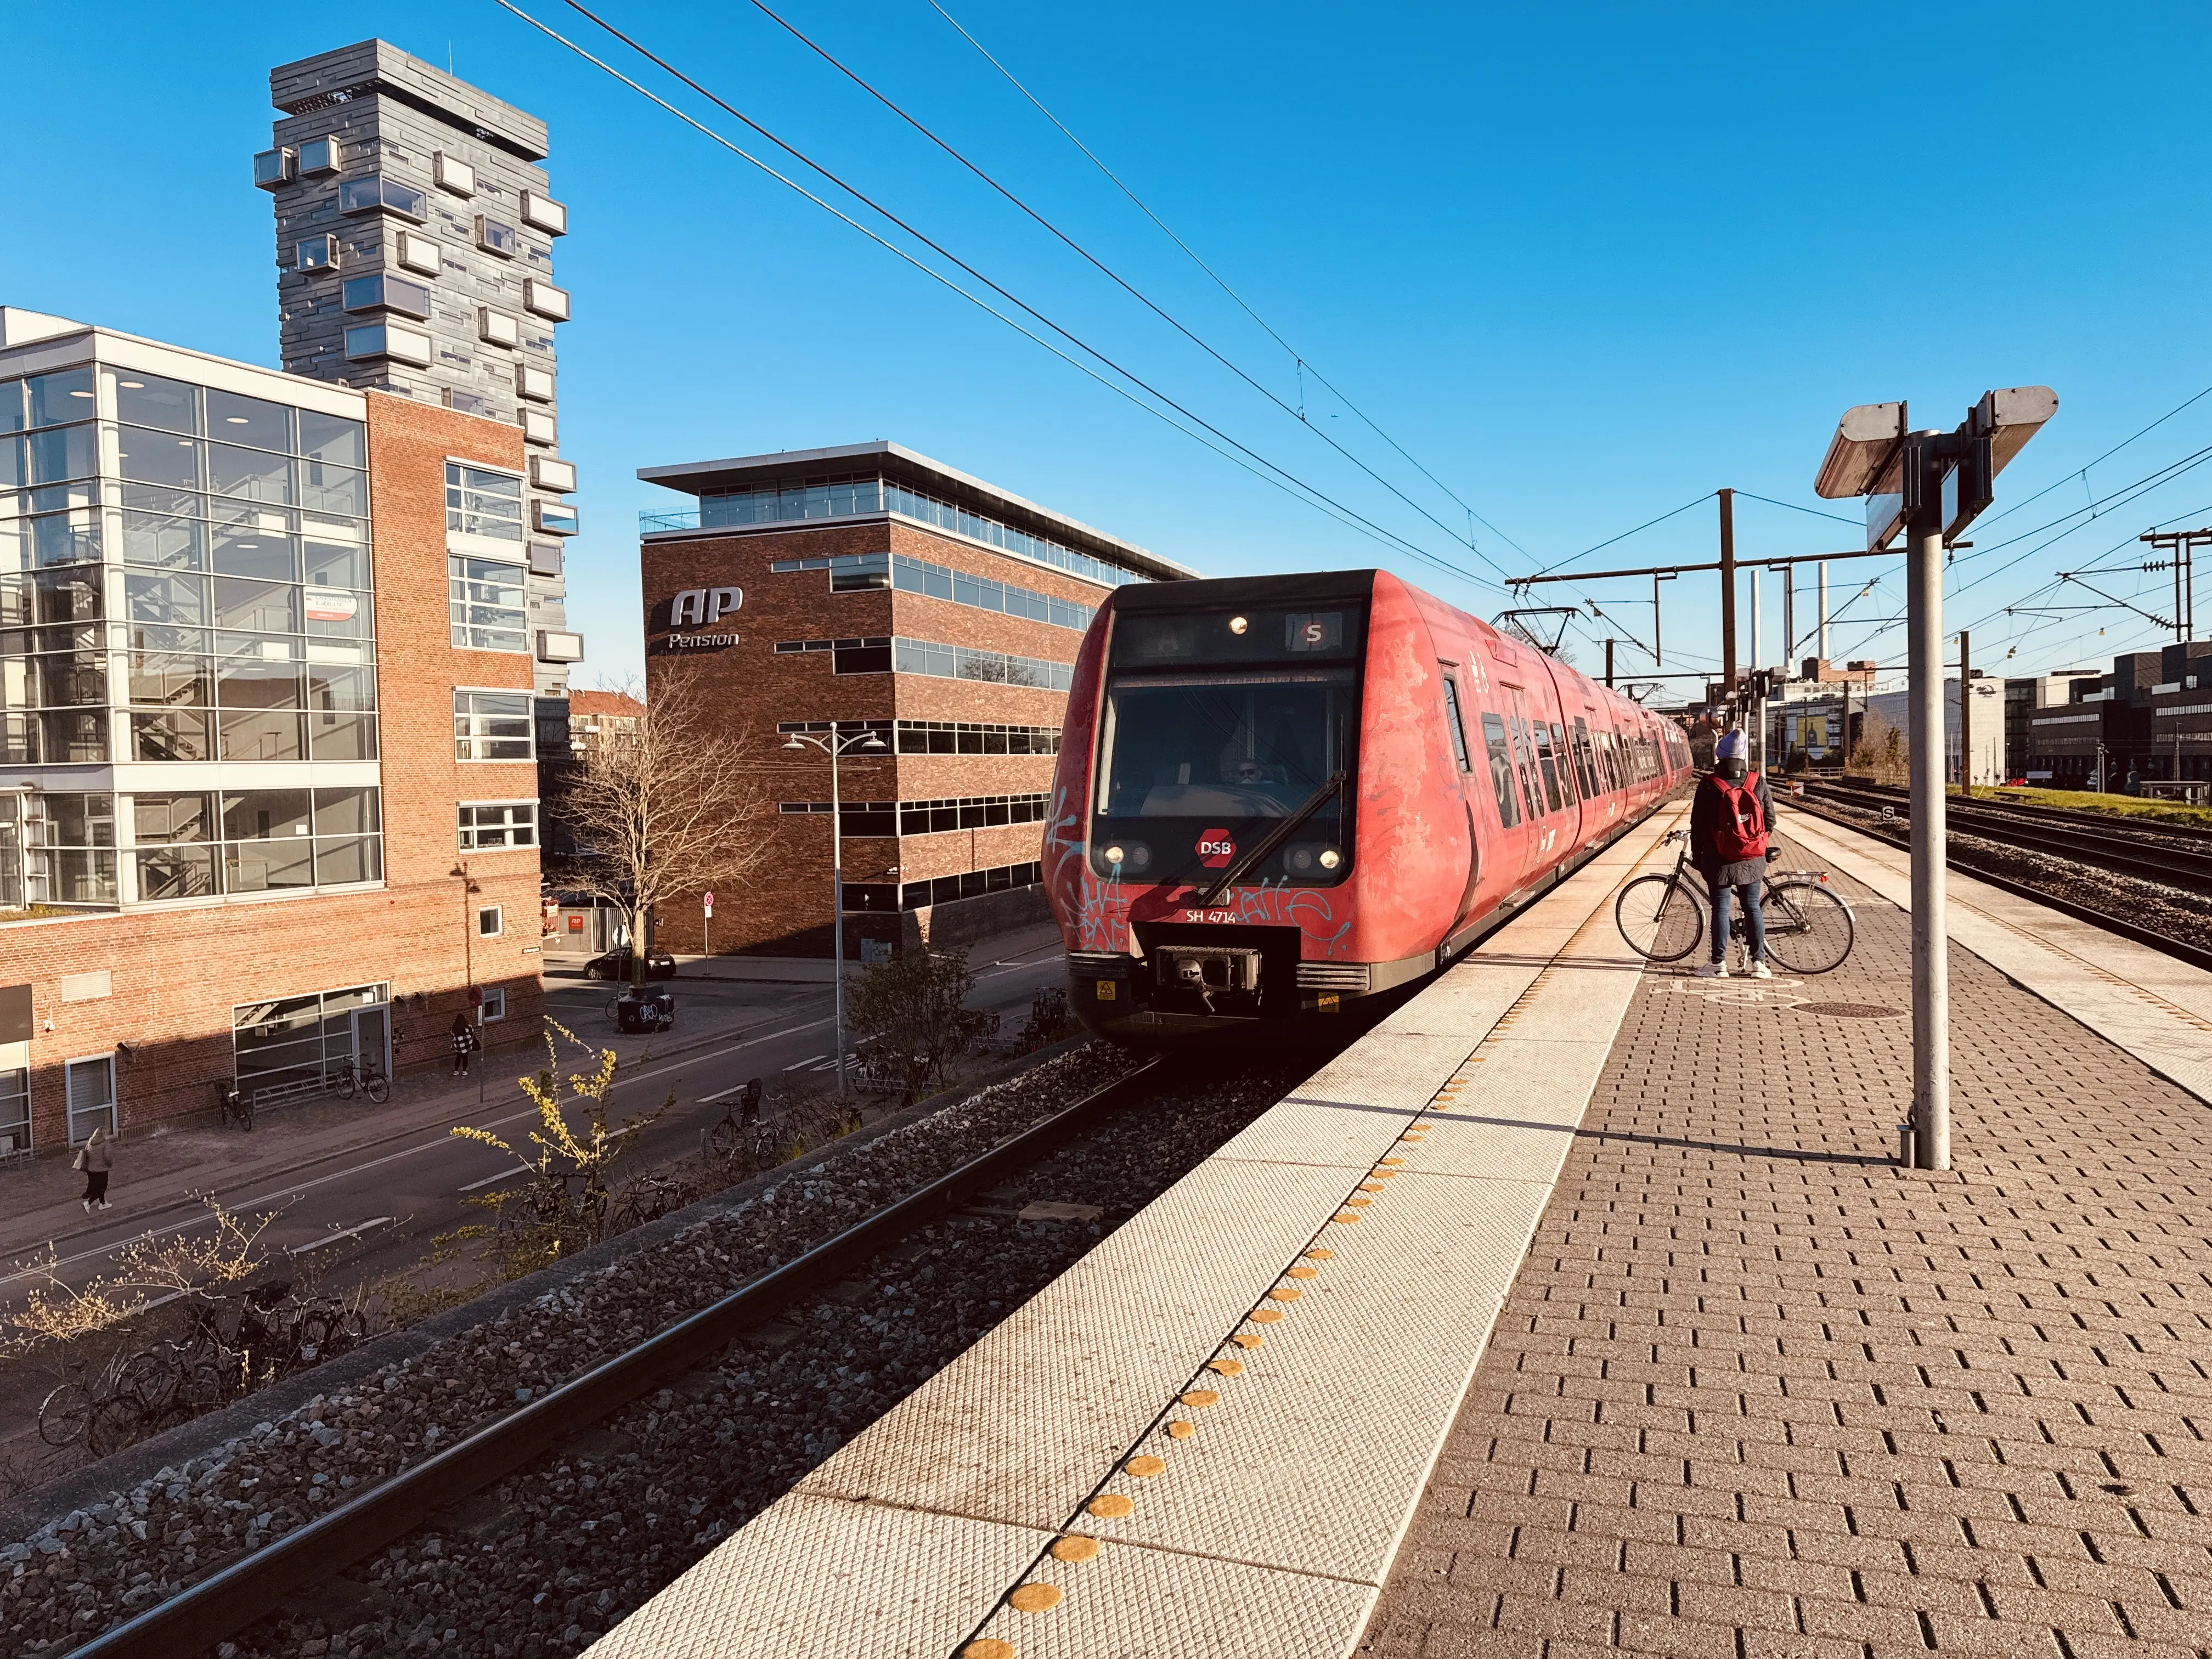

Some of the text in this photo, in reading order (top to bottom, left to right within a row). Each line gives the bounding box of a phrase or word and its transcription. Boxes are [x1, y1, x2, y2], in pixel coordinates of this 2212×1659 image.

[670, 586, 743, 625] AP
[1307, 624, 1322, 641] S
[669, 633, 739, 648] Pension
[1883, 808, 1894, 819] S
[1200, 842, 1232, 855] DSB
[1186, 910, 1235, 923] SH 4714
